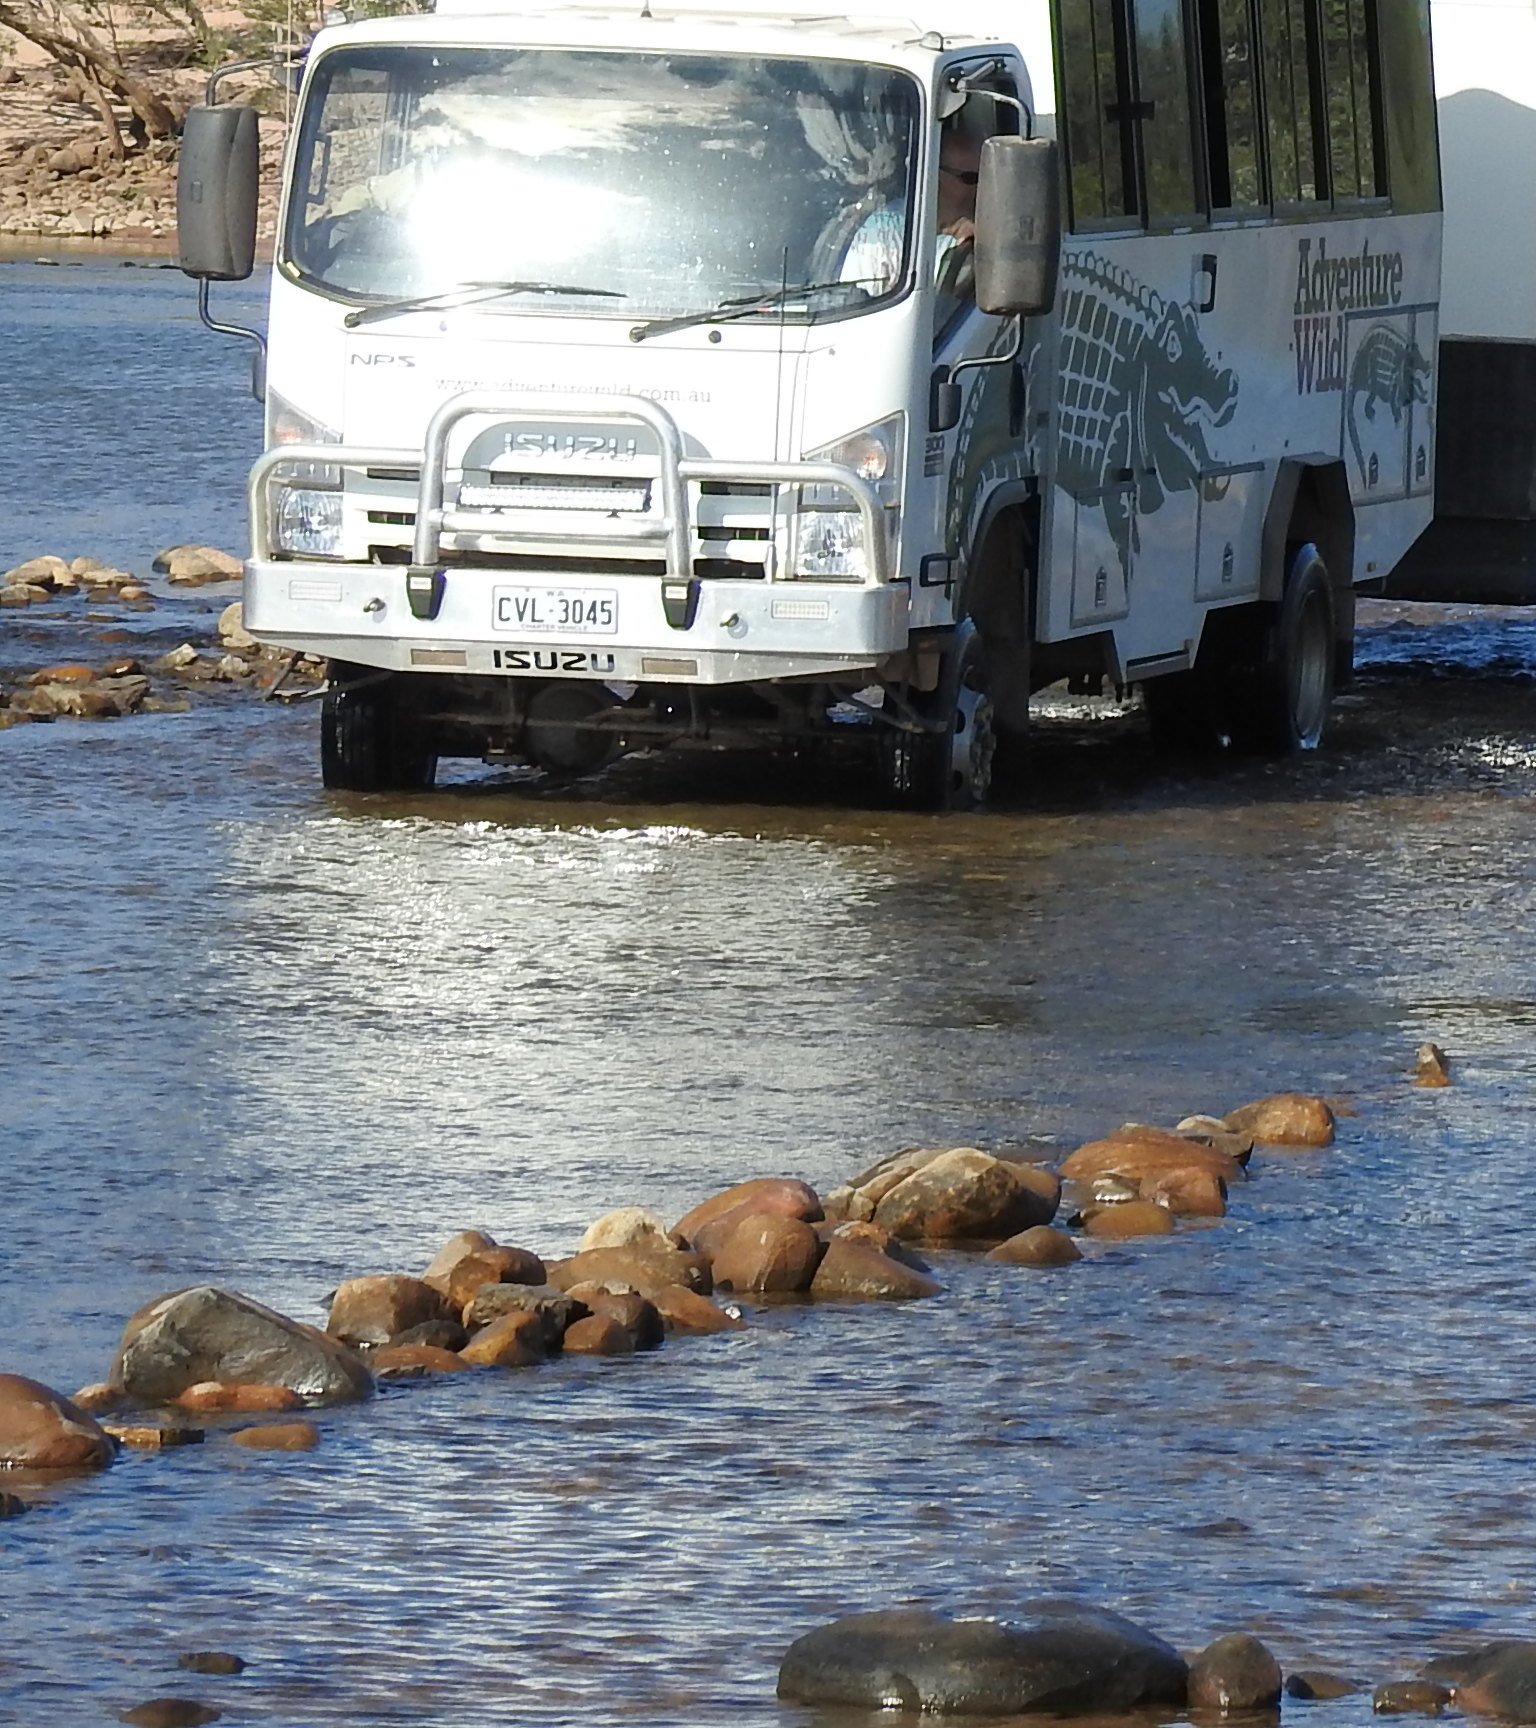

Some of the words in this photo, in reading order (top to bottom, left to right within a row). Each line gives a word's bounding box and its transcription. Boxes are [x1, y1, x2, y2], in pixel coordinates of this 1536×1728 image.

[1294, 237, 1403, 315] Adventure
[1293, 315, 1346, 396] Wild
[503, 432, 638, 462] ISUZU
[493, 649, 615, 673] ISUZU
